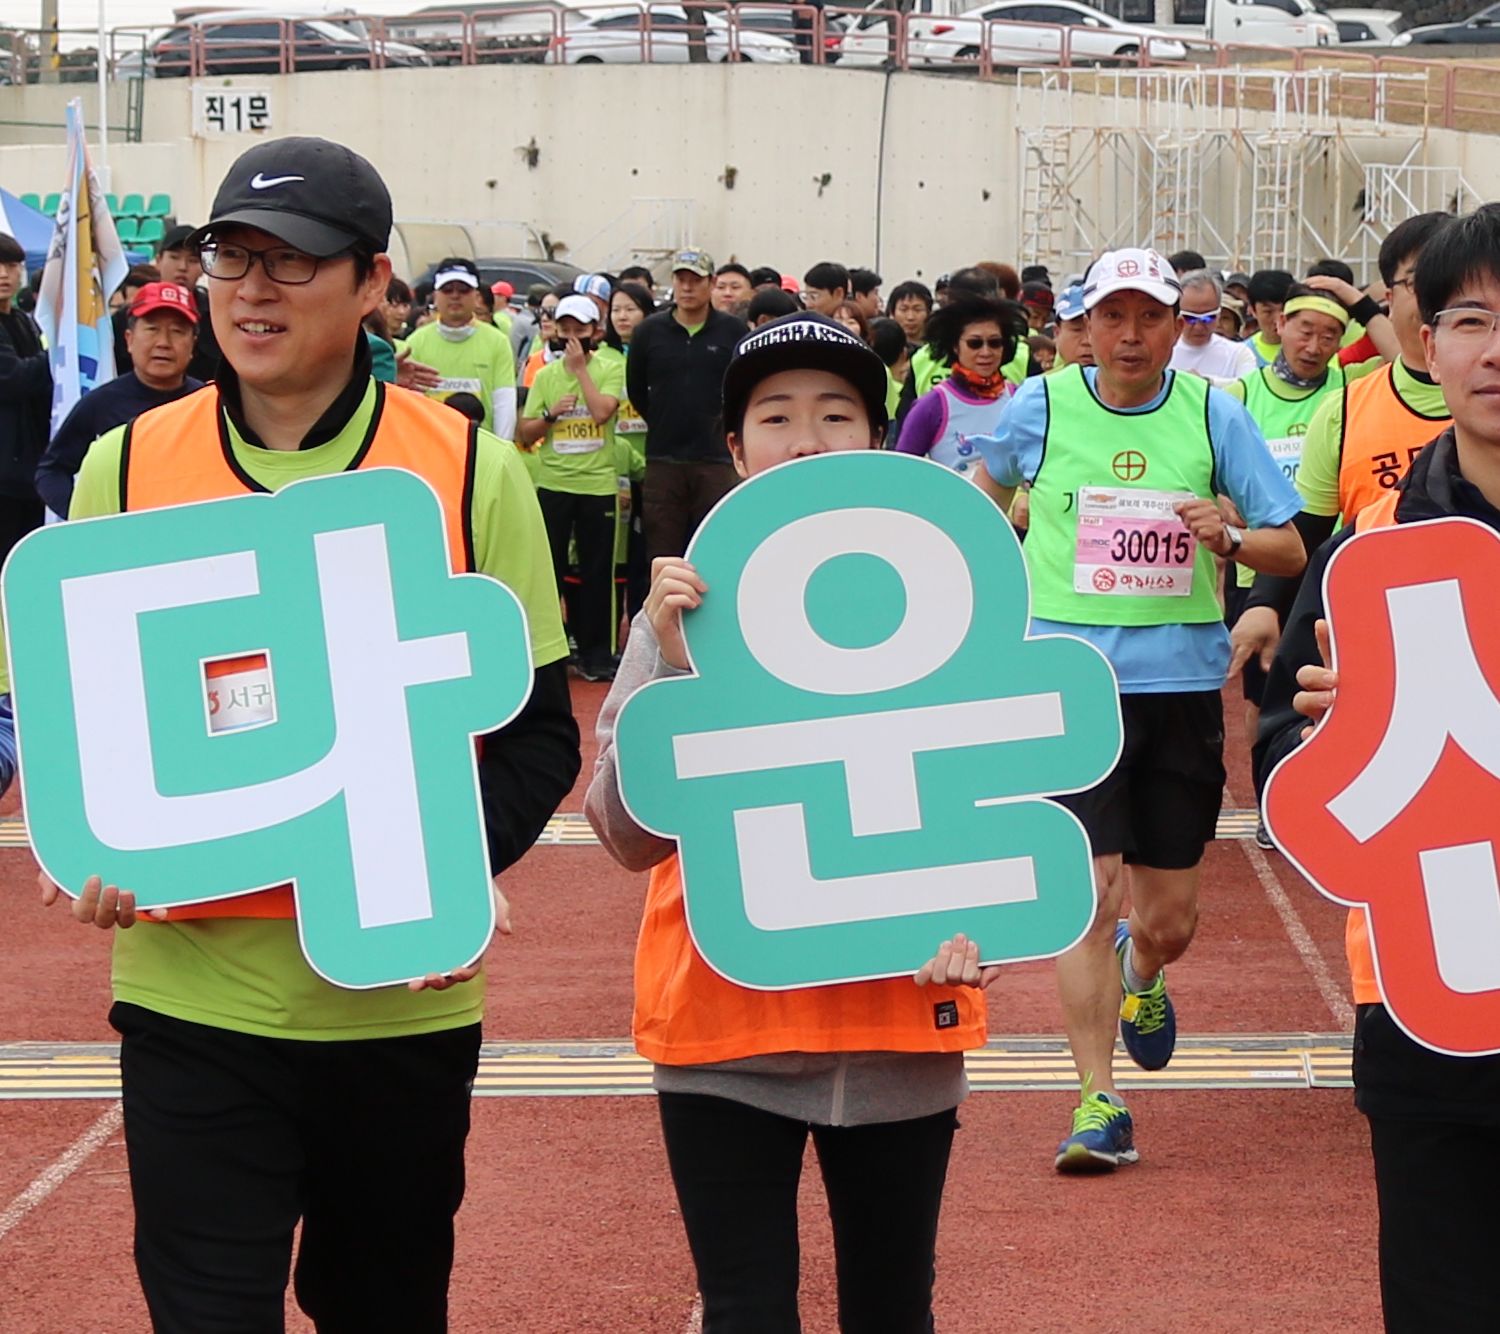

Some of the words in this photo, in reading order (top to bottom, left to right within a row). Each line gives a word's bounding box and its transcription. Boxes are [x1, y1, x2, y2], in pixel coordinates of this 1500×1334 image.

[205, 95, 270, 132] 직1문
[566, 422, 601, 438] 10611
[1110, 528, 1191, 565] 30015
[60, 522, 472, 930] 다
[671, 506, 1065, 933] 운
